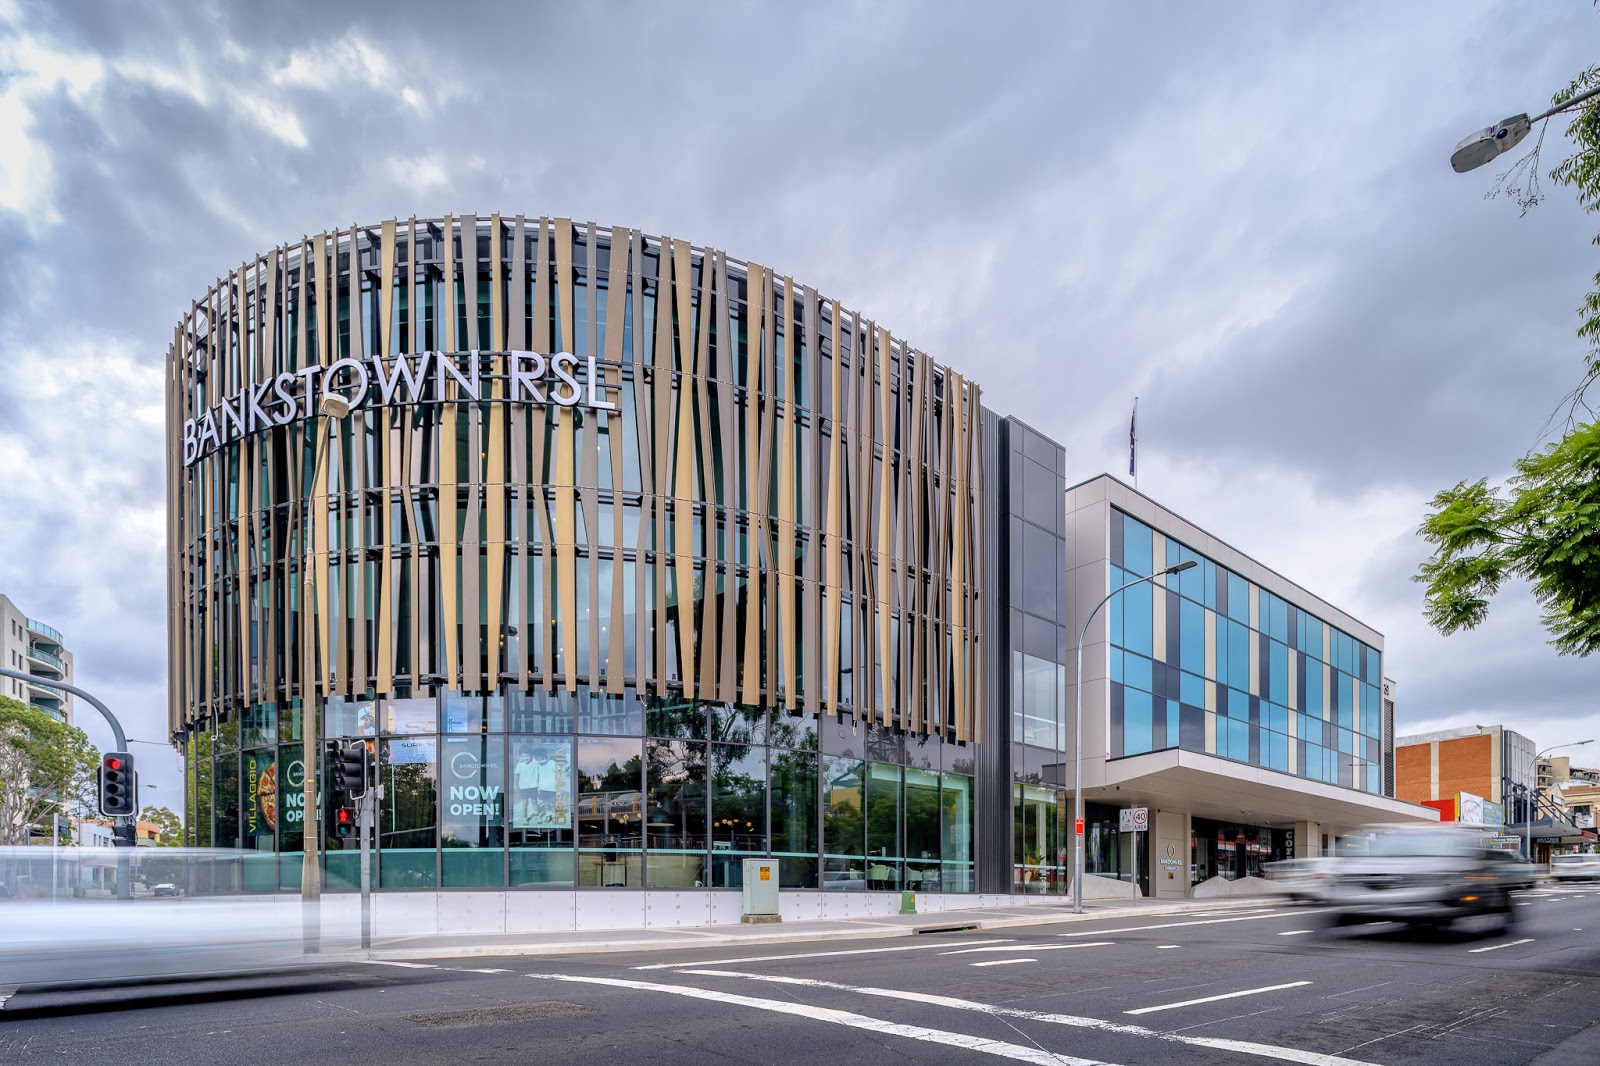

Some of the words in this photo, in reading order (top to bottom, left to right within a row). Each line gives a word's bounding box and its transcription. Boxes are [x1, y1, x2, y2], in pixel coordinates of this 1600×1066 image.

[183, 349, 480, 468] BANKSTOWN
[510, 349, 616, 410] RSL
[450, 785, 500, 801] NOW
[555, 747, 566, 825] VILLAGGIO
[249, 760, 257, 833] VILLAGGIO
[286, 808, 322, 823] OP!
[449, 803, 500, 816] OPEN!
[1135, 812, 1146, 821] 40
